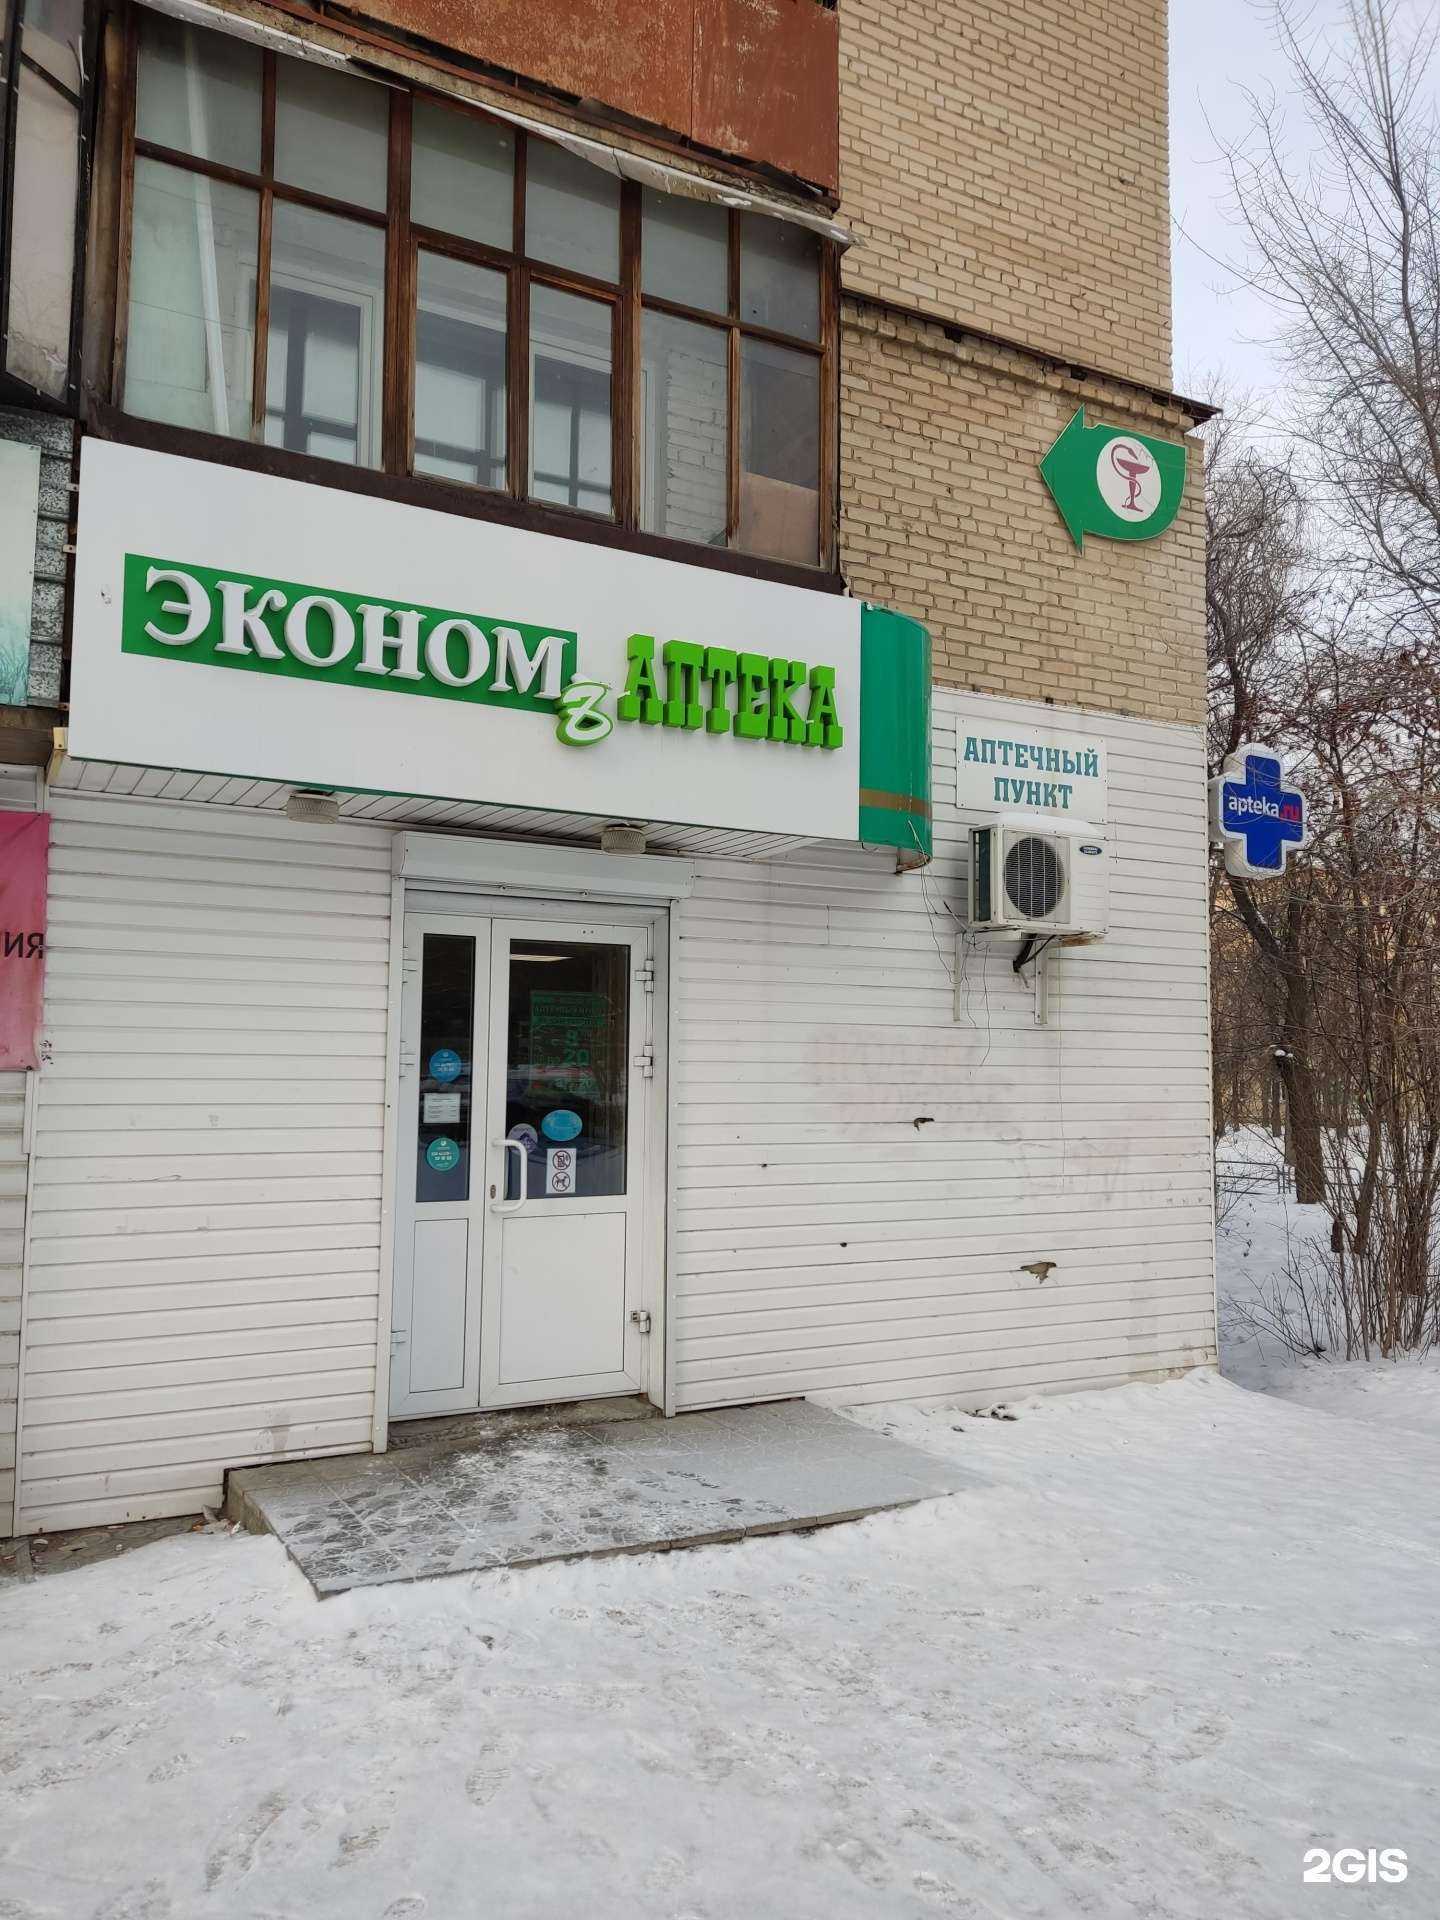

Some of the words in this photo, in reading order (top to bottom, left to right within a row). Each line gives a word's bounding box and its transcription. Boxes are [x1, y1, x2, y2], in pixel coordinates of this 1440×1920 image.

[617, 633, 844, 750] АПТЕКА
[963, 736, 1099, 778] АПТЕЧНЫЙ
[993, 776, 1073, 809] ПУНКТ
[1228, 795, 1300, 821] apteka.ru
